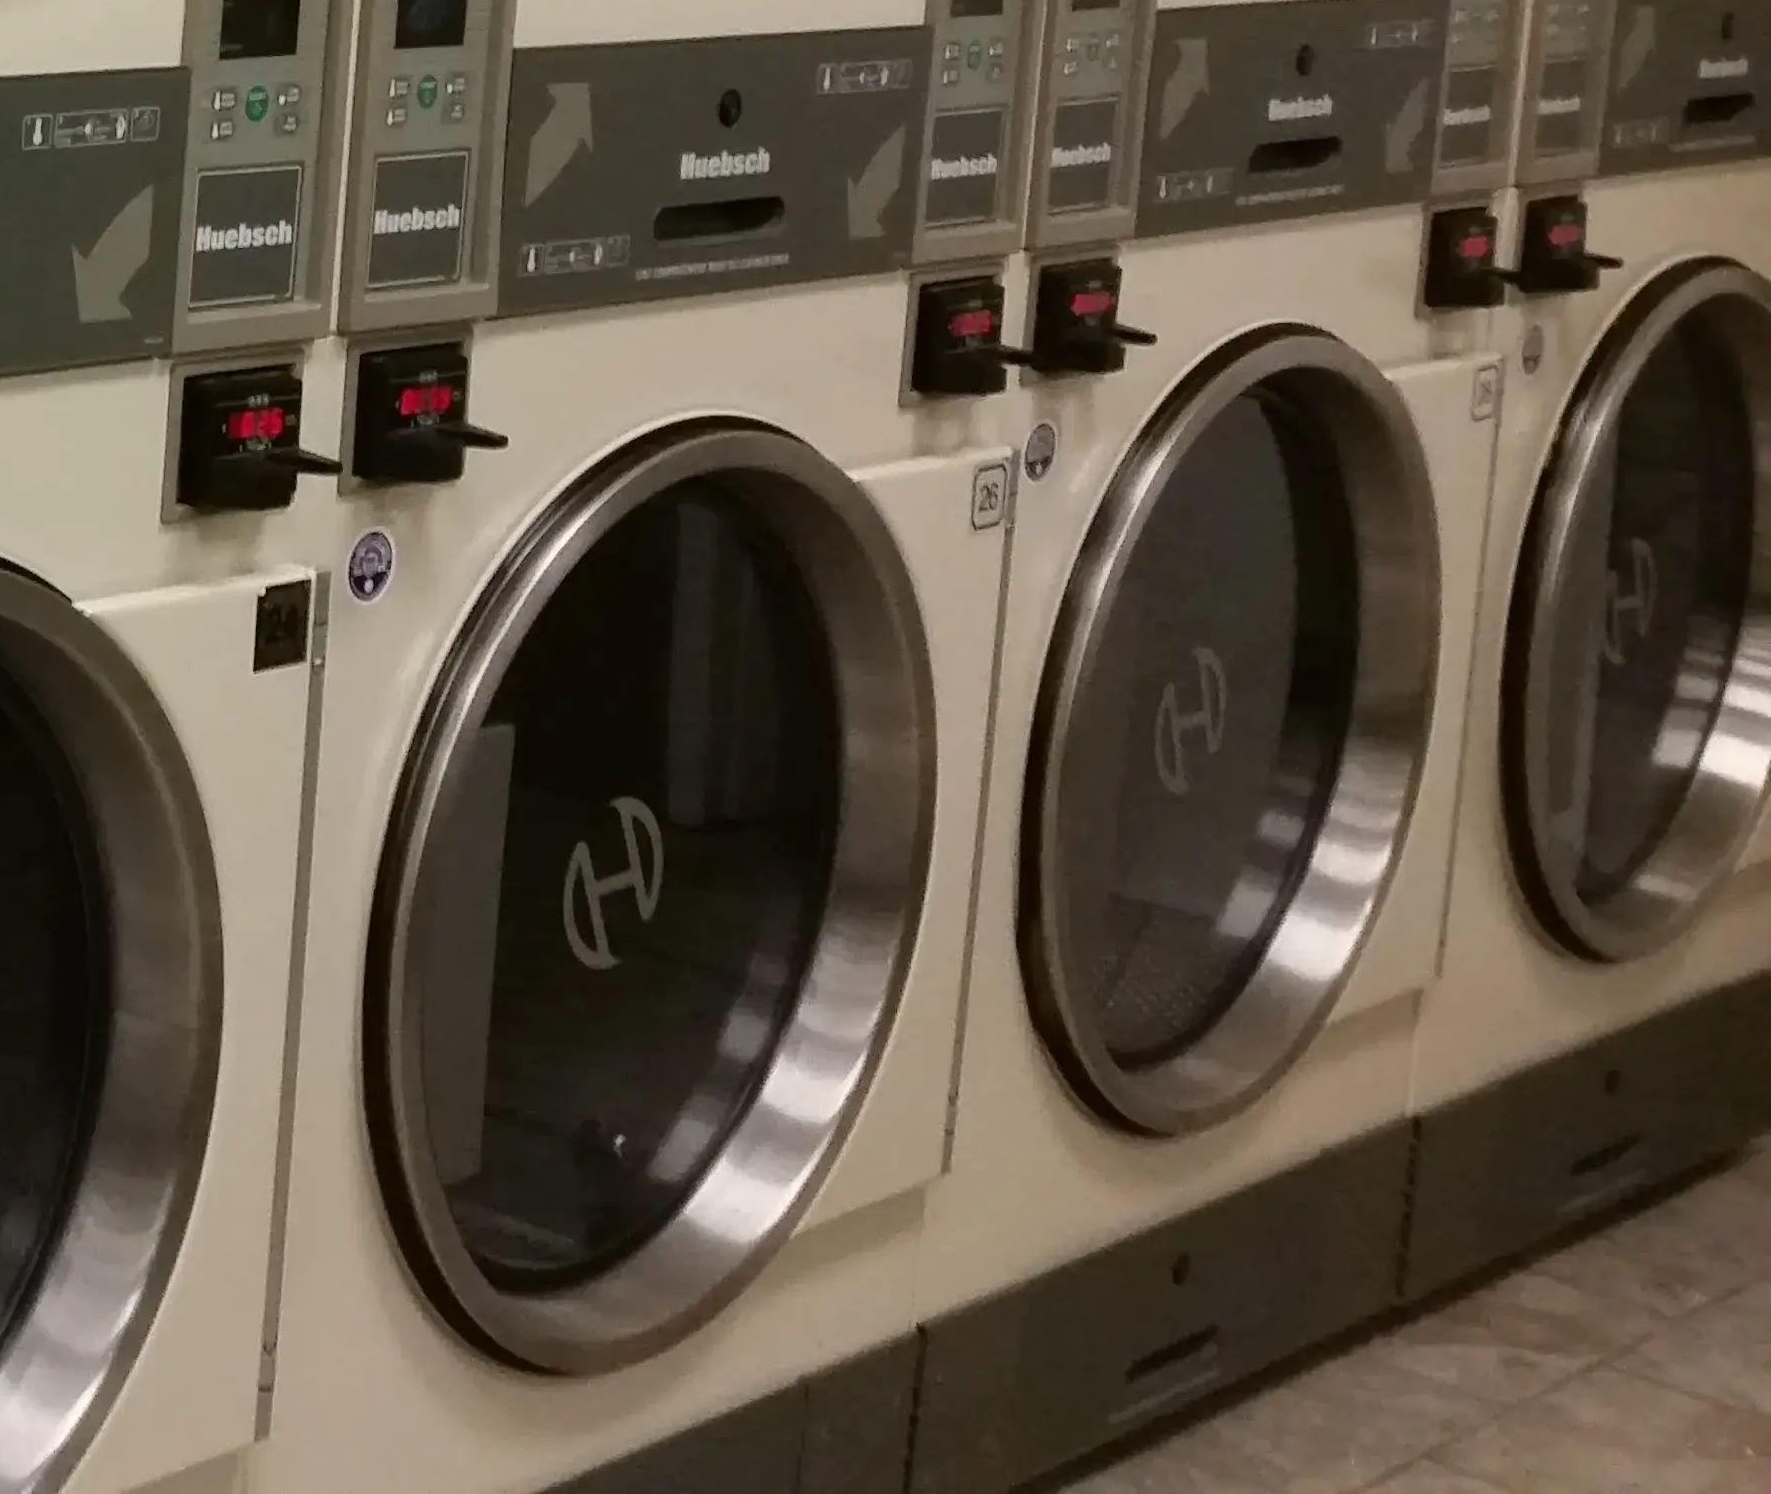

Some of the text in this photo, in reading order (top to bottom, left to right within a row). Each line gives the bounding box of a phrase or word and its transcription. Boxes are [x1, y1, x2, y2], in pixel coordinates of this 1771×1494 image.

[680, 145, 771, 180] Huebsch
[196, 219, 293, 253] Huebsch
[374, 203, 460, 235] Huebsch
